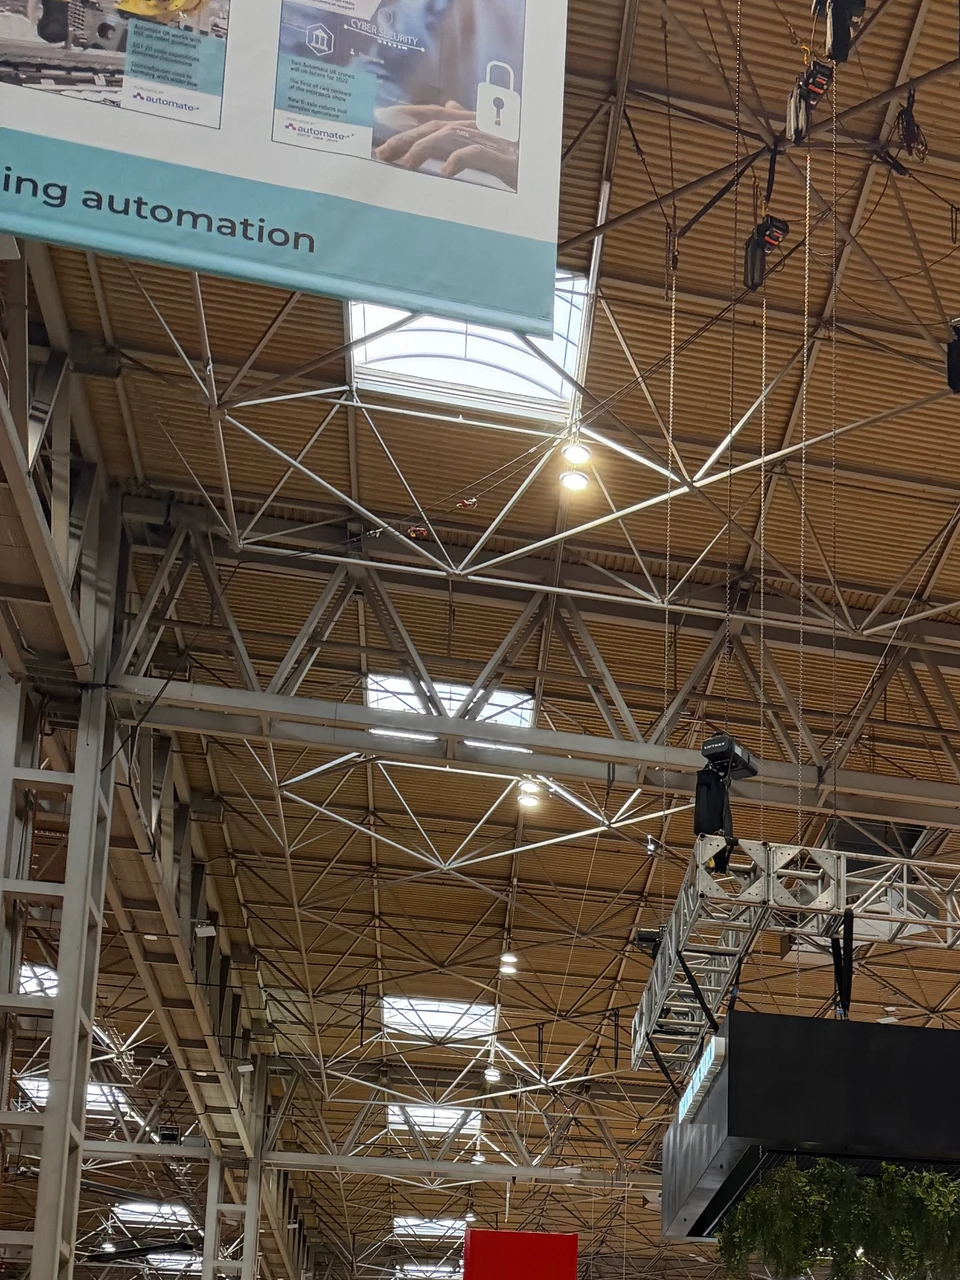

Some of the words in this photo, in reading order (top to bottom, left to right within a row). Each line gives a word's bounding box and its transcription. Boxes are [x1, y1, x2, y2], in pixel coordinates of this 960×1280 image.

[350, 18, 377, 34] CYBER
[146, 95, 194, 112] automate
[297, 124, 345, 141] automate
[2, 166, 68, 208] ing
[82, 189, 315, 254] automation
